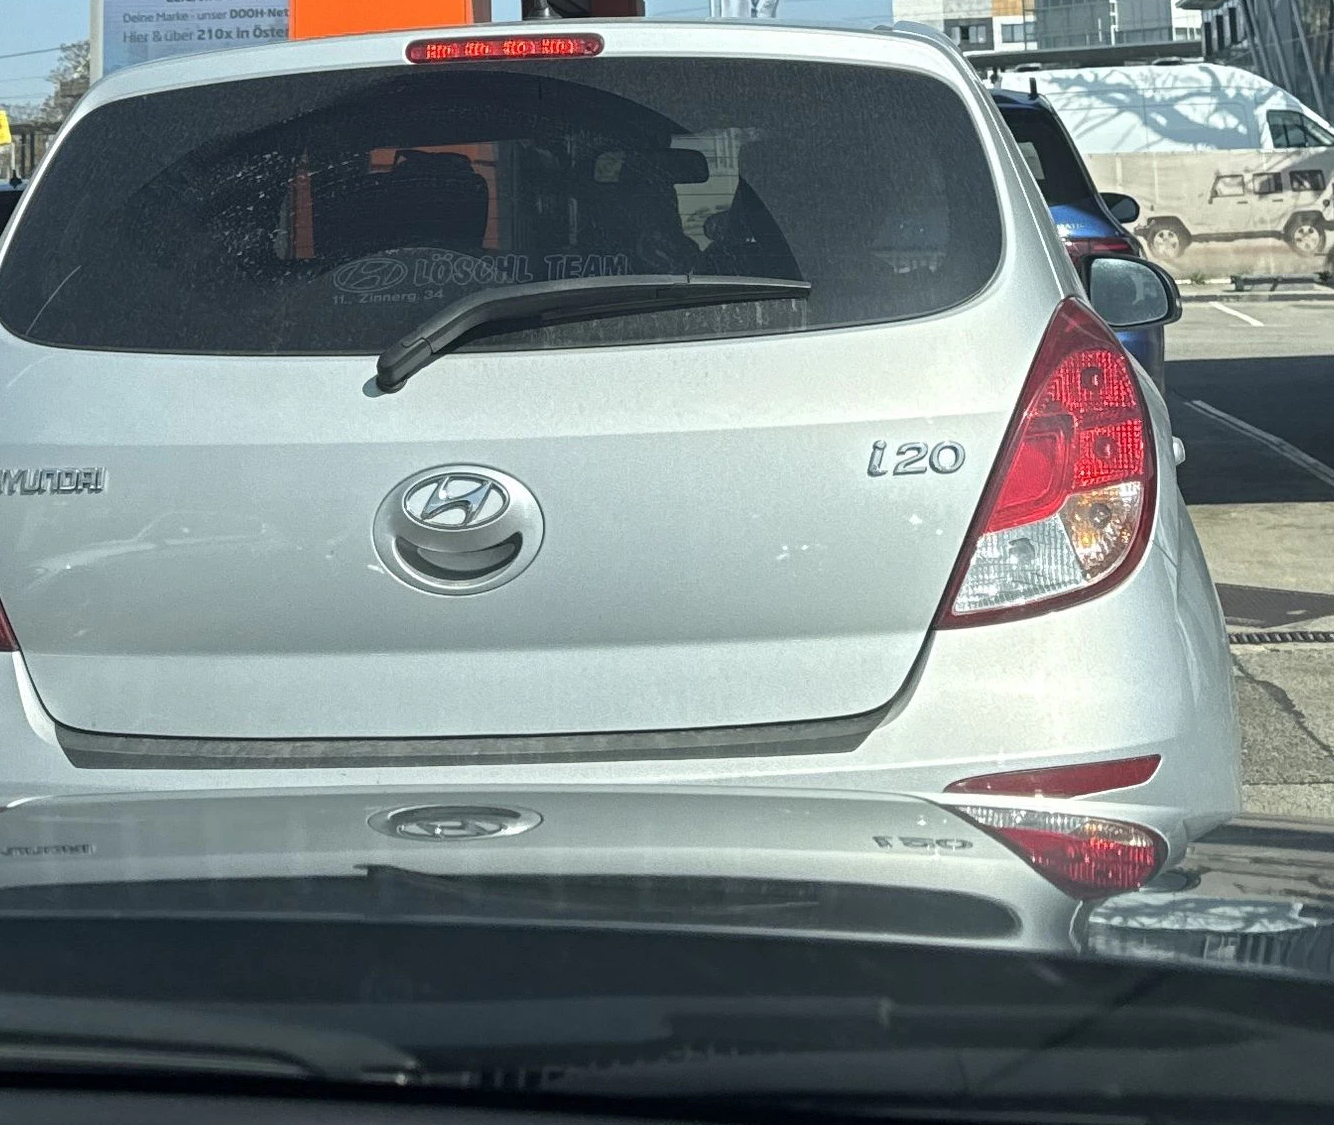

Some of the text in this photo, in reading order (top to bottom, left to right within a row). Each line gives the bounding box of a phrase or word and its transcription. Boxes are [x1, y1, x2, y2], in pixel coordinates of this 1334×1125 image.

[123, 12, 154, 23] Deine
[156, 10, 189, 21] Marke
[197, 11, 228, 21] unser
[123, 32, 149, 44] Hier
[152, 31, 163, 42] &
[164, 30, 194, 42] über
[197, 28, 233, 41] 210x
[236, 28, 250, 39] in
[413, 253, 629, 287] LÖSCHL TEAM
[423, 288, 444, 300] 34
[866, 439, 967, 478] i20
